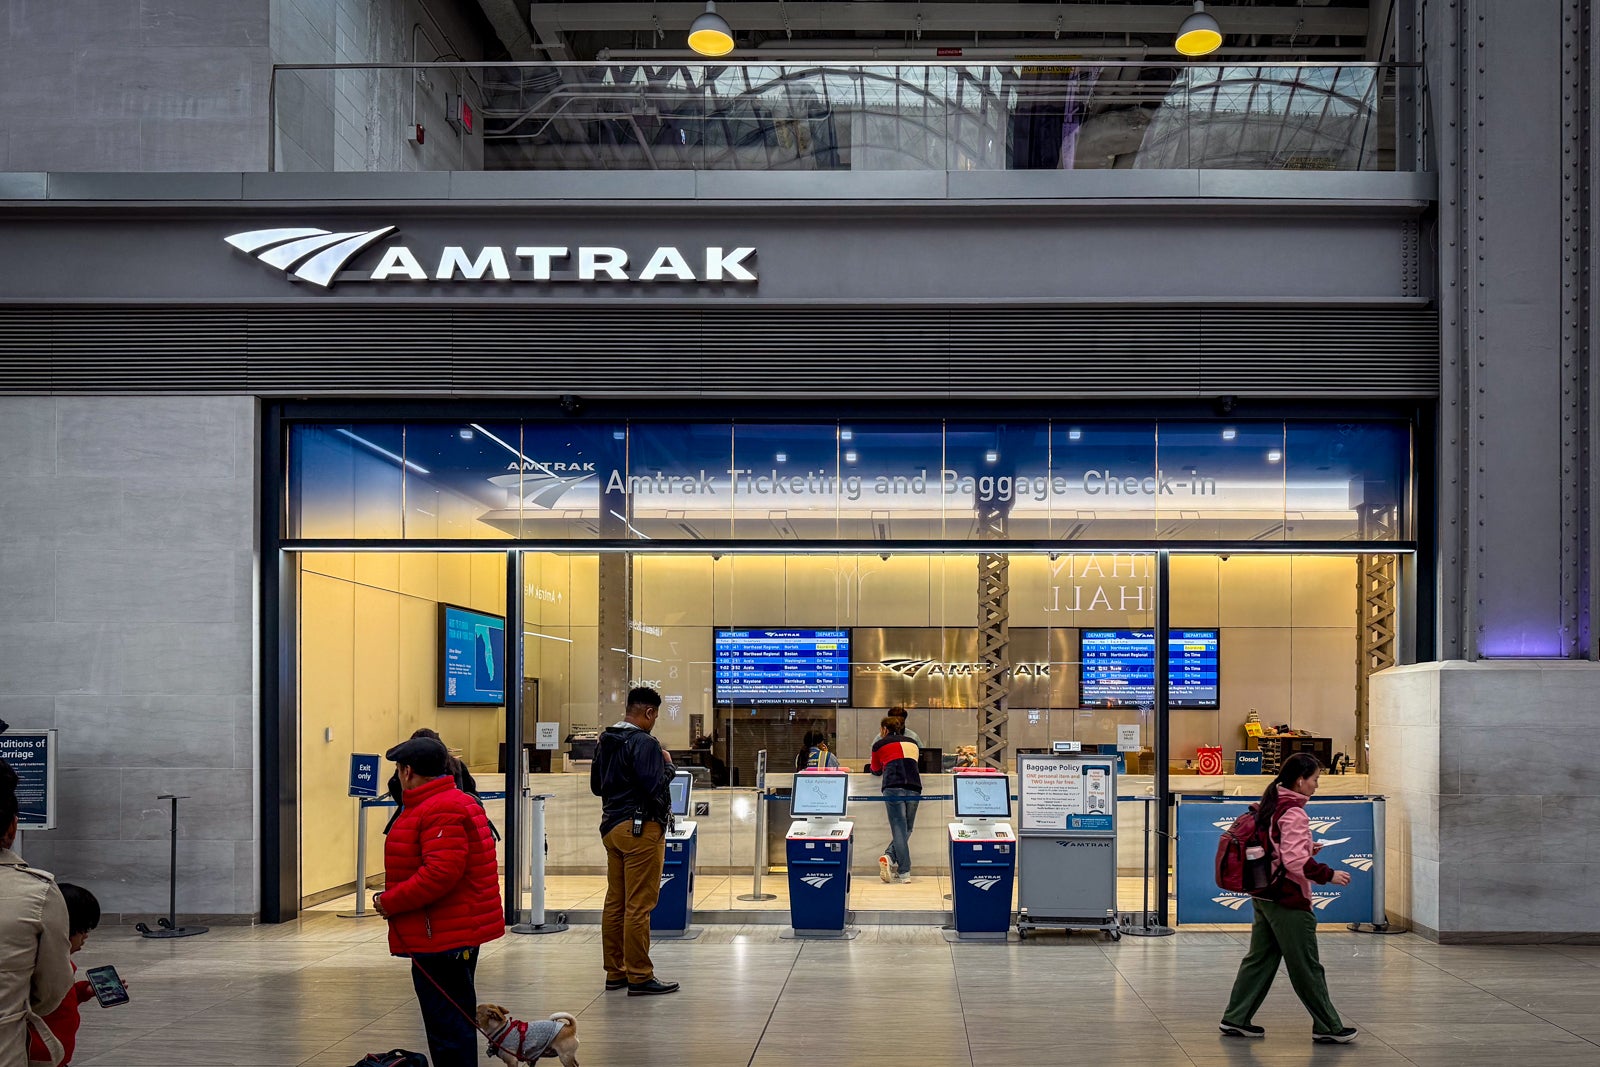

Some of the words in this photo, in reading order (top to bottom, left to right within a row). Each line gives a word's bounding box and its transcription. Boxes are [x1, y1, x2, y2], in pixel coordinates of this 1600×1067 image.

[370, 247, 757, 280] AMTRAK
[507, 462, 595, 471] AMTRAK
[605, 469, 716, 495] Amtrak
[727, 469, 862, 501] Ticketing
[874, 469, 927, 495] and
[940, 469, 1067, 501] Baggage
[1083, 469, 1216, 495] Check-in
[928, 664, 1050, 676] AMAK
[36, 739, 45, 748] of
[358, 773, 371, 781] only
